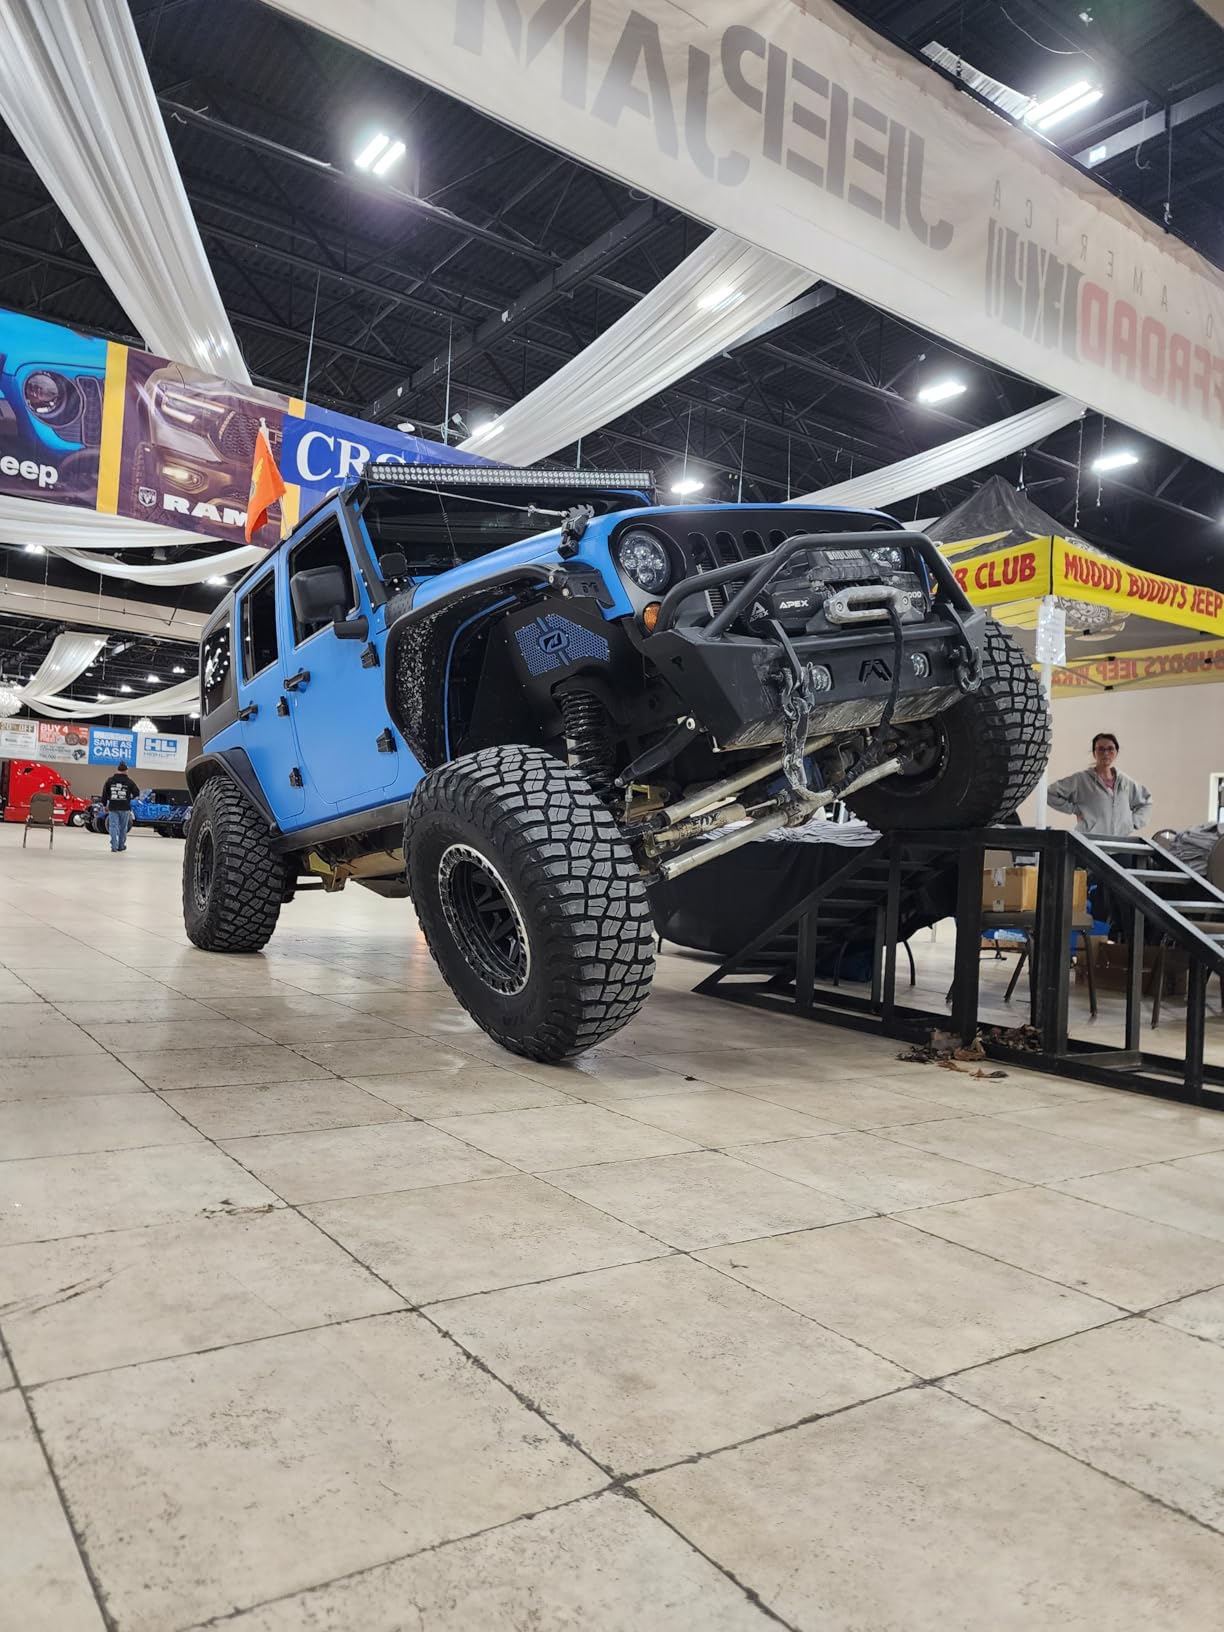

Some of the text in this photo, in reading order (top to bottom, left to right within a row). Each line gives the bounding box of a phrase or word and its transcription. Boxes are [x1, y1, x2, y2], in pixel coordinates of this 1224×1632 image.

[163, 493, 248, 527] RAM
[974, 552, 1036, 590] CLUB
[1064, 552, 1223, 618] MUDDY BUDDYS JEEP
[779, 600, 809, 609] APEX
[41, 723, 60, 733] BUY
[62, 725, 69, 734] 4
[94, 738, 132, 749] SAME AS
[94, 746, 132, 759] CASH!
